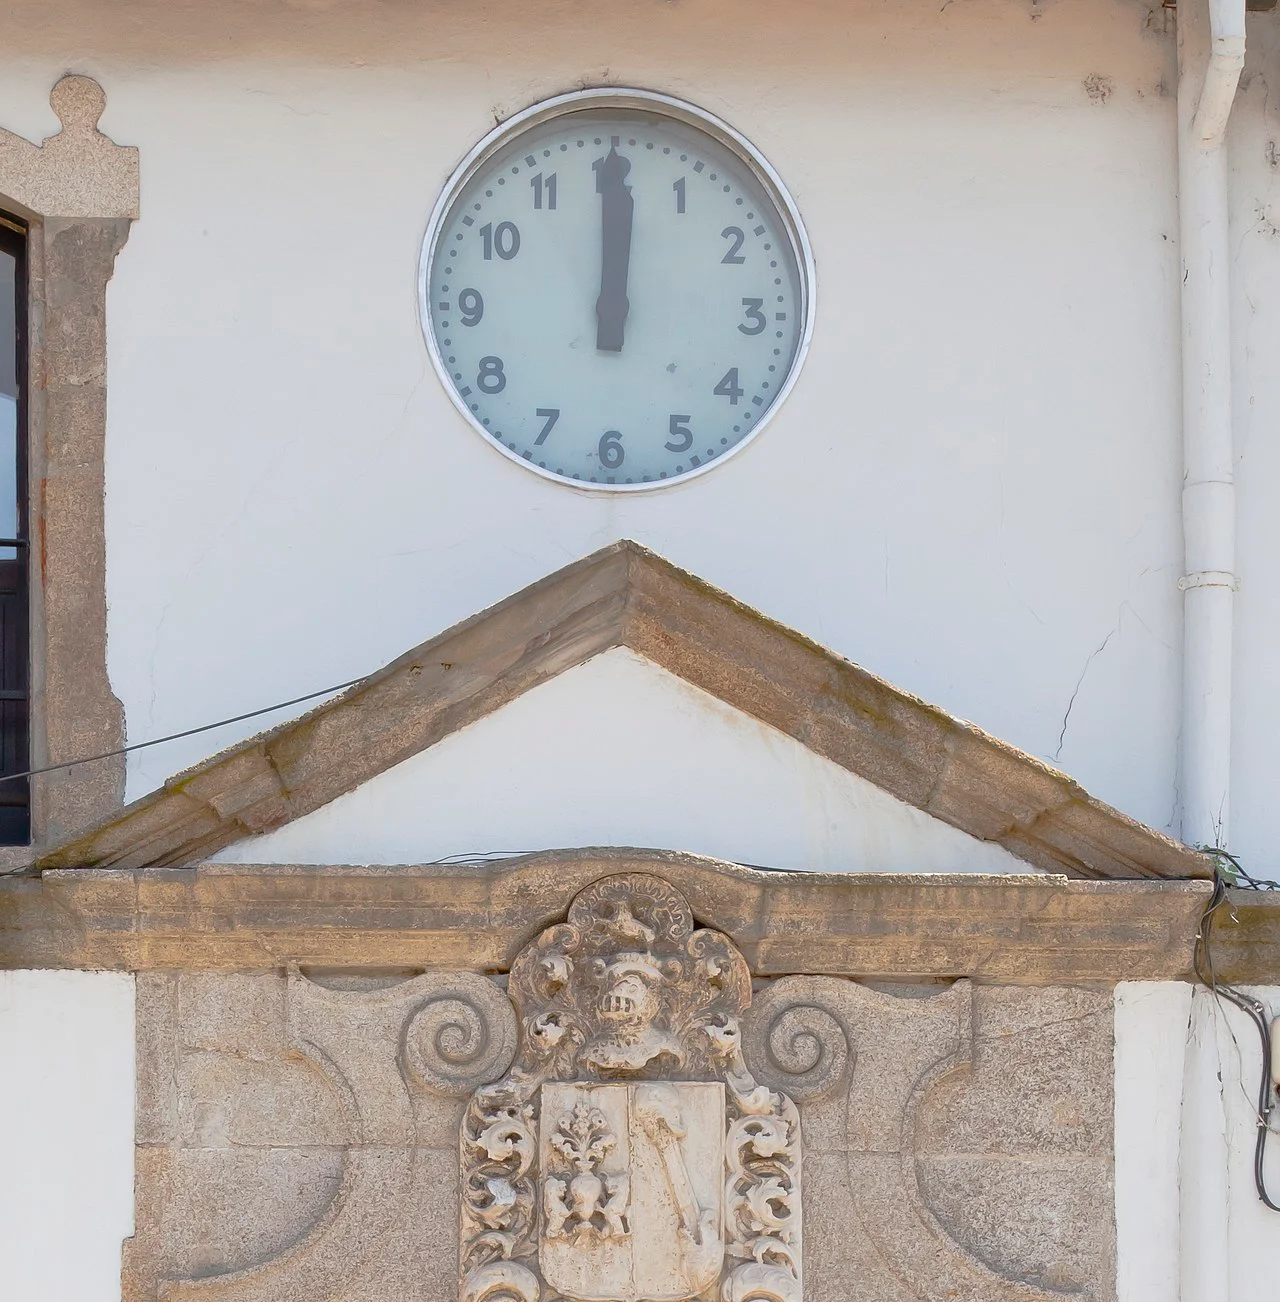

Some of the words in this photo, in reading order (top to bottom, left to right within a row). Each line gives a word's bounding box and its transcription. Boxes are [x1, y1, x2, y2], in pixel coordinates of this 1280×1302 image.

[530, 171, 557, 210] 11
[672, 176, 686, 214] 1
[479, 221, 521, 261] 10
[720, 226, 746, 265] 2
[458, 288, 484, 327] 9
[737, 297, 767, 336] 3
[476, 356, 507, 395] 8
[713, 367, 744, 405] 4
[533, 408, 561, 446] 7
[664, 414, 694, 453] 5
[599, 430, 625, 469] 6
